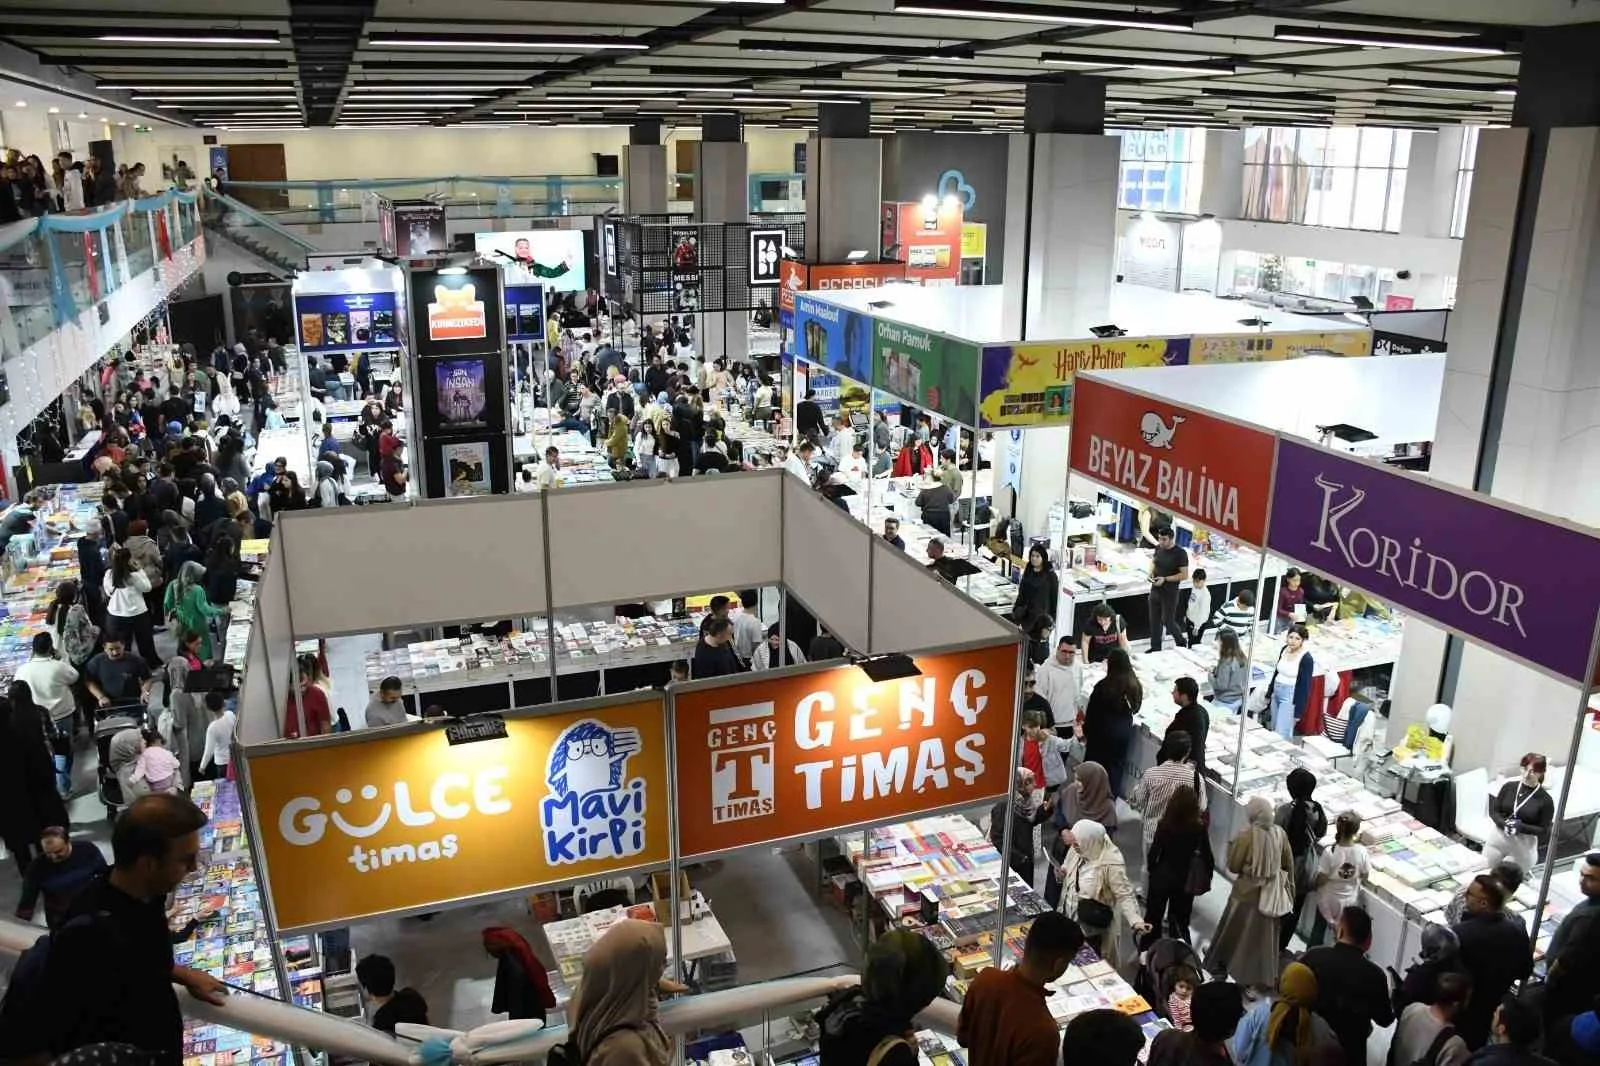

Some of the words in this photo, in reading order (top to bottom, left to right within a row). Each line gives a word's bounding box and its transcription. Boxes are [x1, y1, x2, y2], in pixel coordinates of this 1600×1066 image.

[878, 323, 900, 342] Orhan
[902, 329, 931, 351] Pamuk
[1055, 348, 1091, 381] Harry
[1091, 344, 1126, 369] Potter
[1088, 434, 1153, 494] BEYAZ
[1156, 459, 1239, 531] BALİNA
[794, 668, 988, 750] GENÇ
[707, 720, 777, 748] GENÇ
[278, 765, 512, 846] GÜLCE
[543, 781, 643, 827] Mavi
[348, 834, 459, 872] timaş
